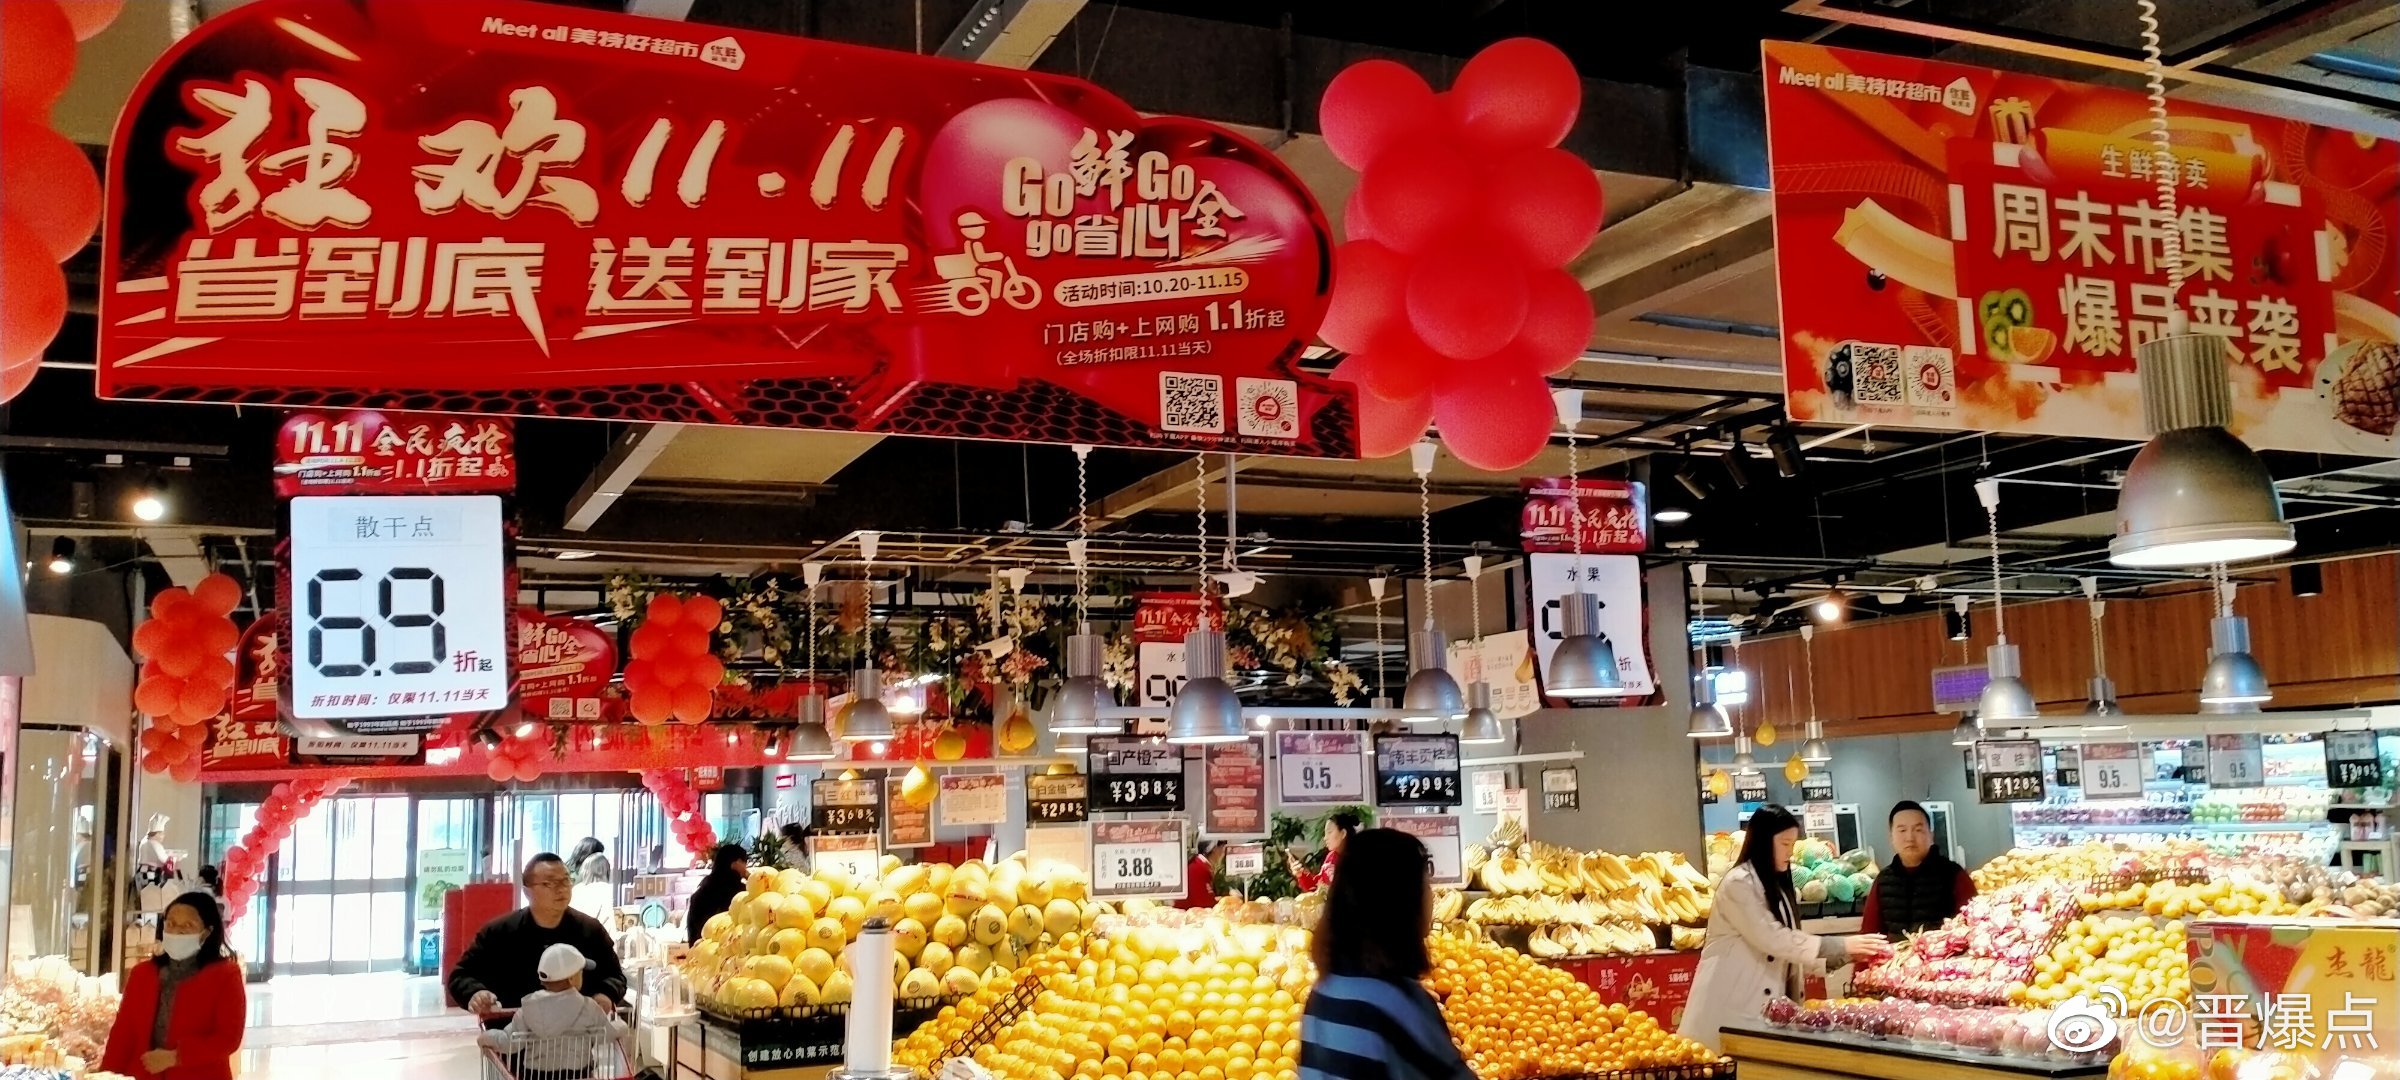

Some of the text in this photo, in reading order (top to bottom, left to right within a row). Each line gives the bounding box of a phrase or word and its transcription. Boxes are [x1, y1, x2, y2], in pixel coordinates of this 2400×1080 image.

[481, 16, 699, 58] Meet all 美特好超市
[1779, 66, 1942, 103] Meet all 美特好超市
[176, 78, 905, 234] 狂欢11.11
[1992, 183, 2234, 282] 周末市集
[175, 236, 909, 359] 省到底 送到家
[1062, 271, 1243, 302] 活动时间:10.20-11.15
[2058, 273, 2303, 375] 爆品来袭
[291, 420, 507, 457] 11.11 全民疯抢
[395, 456, 482, 479] 1.1折起
[355, 515, 435, 539] 散干点
[1528, 504, 1566, 526] 11.11
[1567, 567, 1601, 582] 水果
[307, 566, 447, 678] 6.9
[1108, 749, 1168, 767] 国产橙子
[2230, 762, 2246, 779] 9.5
[1302, 766, 1332, 790] 9.5
[2099, 769, 2121, 789] 9.5
[1118, 857, 1153, 877] 3.88
